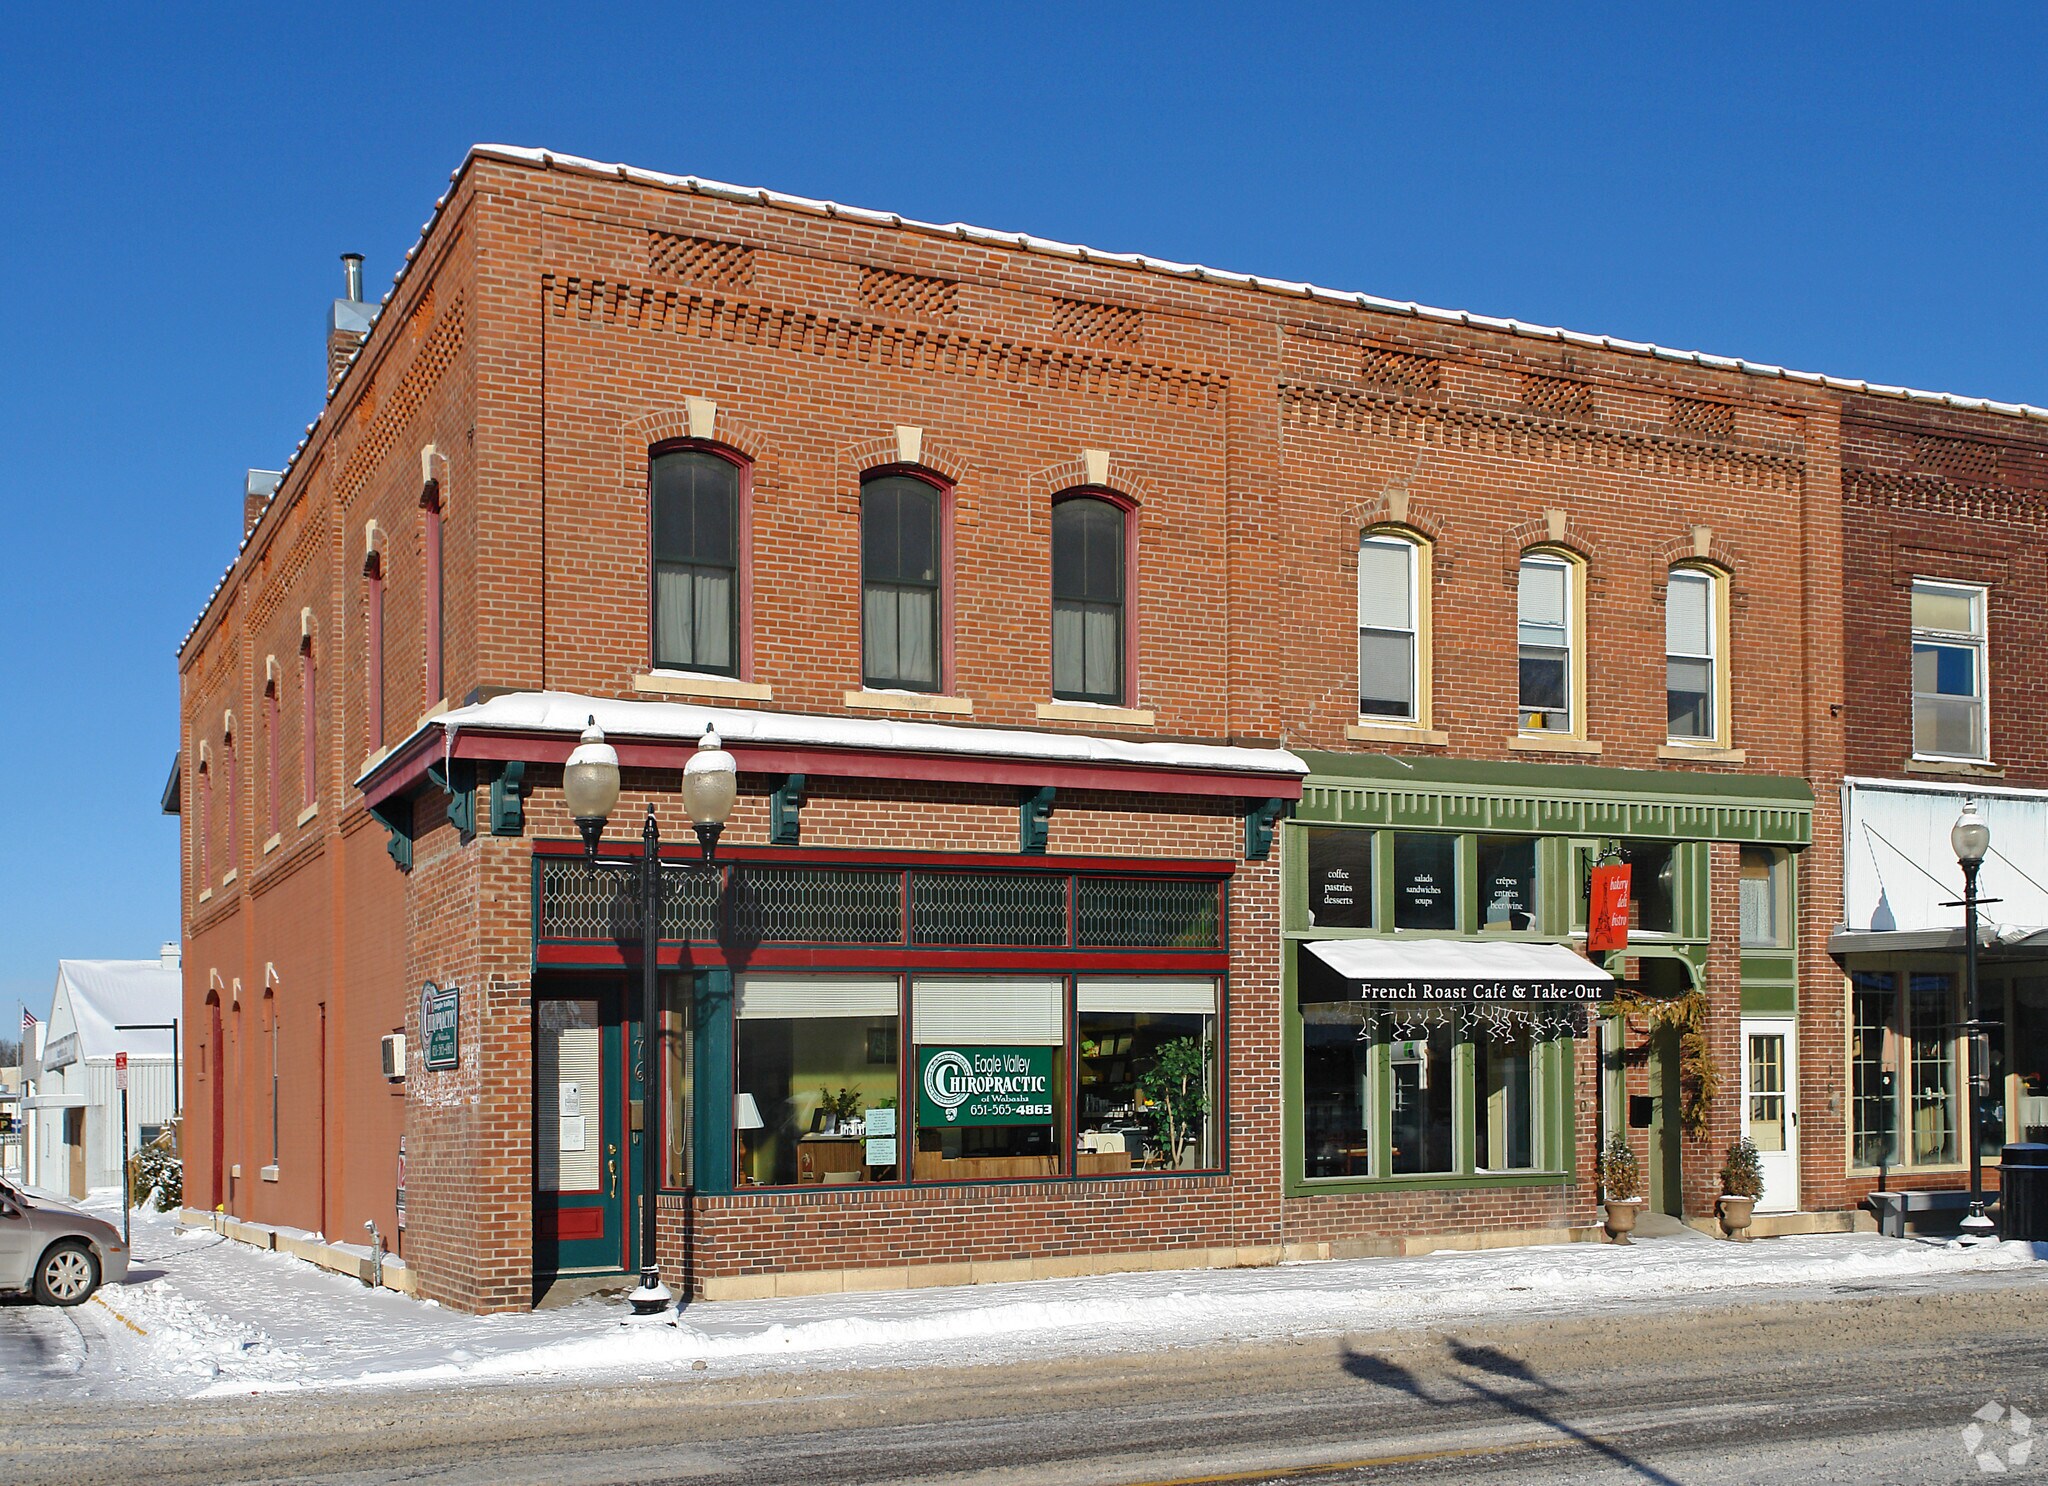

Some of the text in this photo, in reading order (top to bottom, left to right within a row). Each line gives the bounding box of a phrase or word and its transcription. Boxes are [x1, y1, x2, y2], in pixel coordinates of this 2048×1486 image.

[1327, 868, 1350, 879] coffee
[1414, 873, 1433, 883] salads
[1324, 883, 1353, 894] pastries
[1406, 884, 1441, 894] sandwiches
[1610, 876, 1628, 893] bakery
[1323, 894, 1353, 905] desserts
[1414, 896, 1433, 907] soups
[1617, 893, 1627, 908] deli
[1611, 912, 1627, 927] bistro
[1361, 983, 1602, 999] French Roast Café & Take-Out
[633, 1020, 644, 1082] 176
[974, 1054, 1031, 1077] Eagle Valley
[935, 1063, 1046, 1097] CHIROPRACTIC
[981, 1094, 1030, 1103] of Wabasha
[970, 1103, 1053, 1116] 651-565-4863
